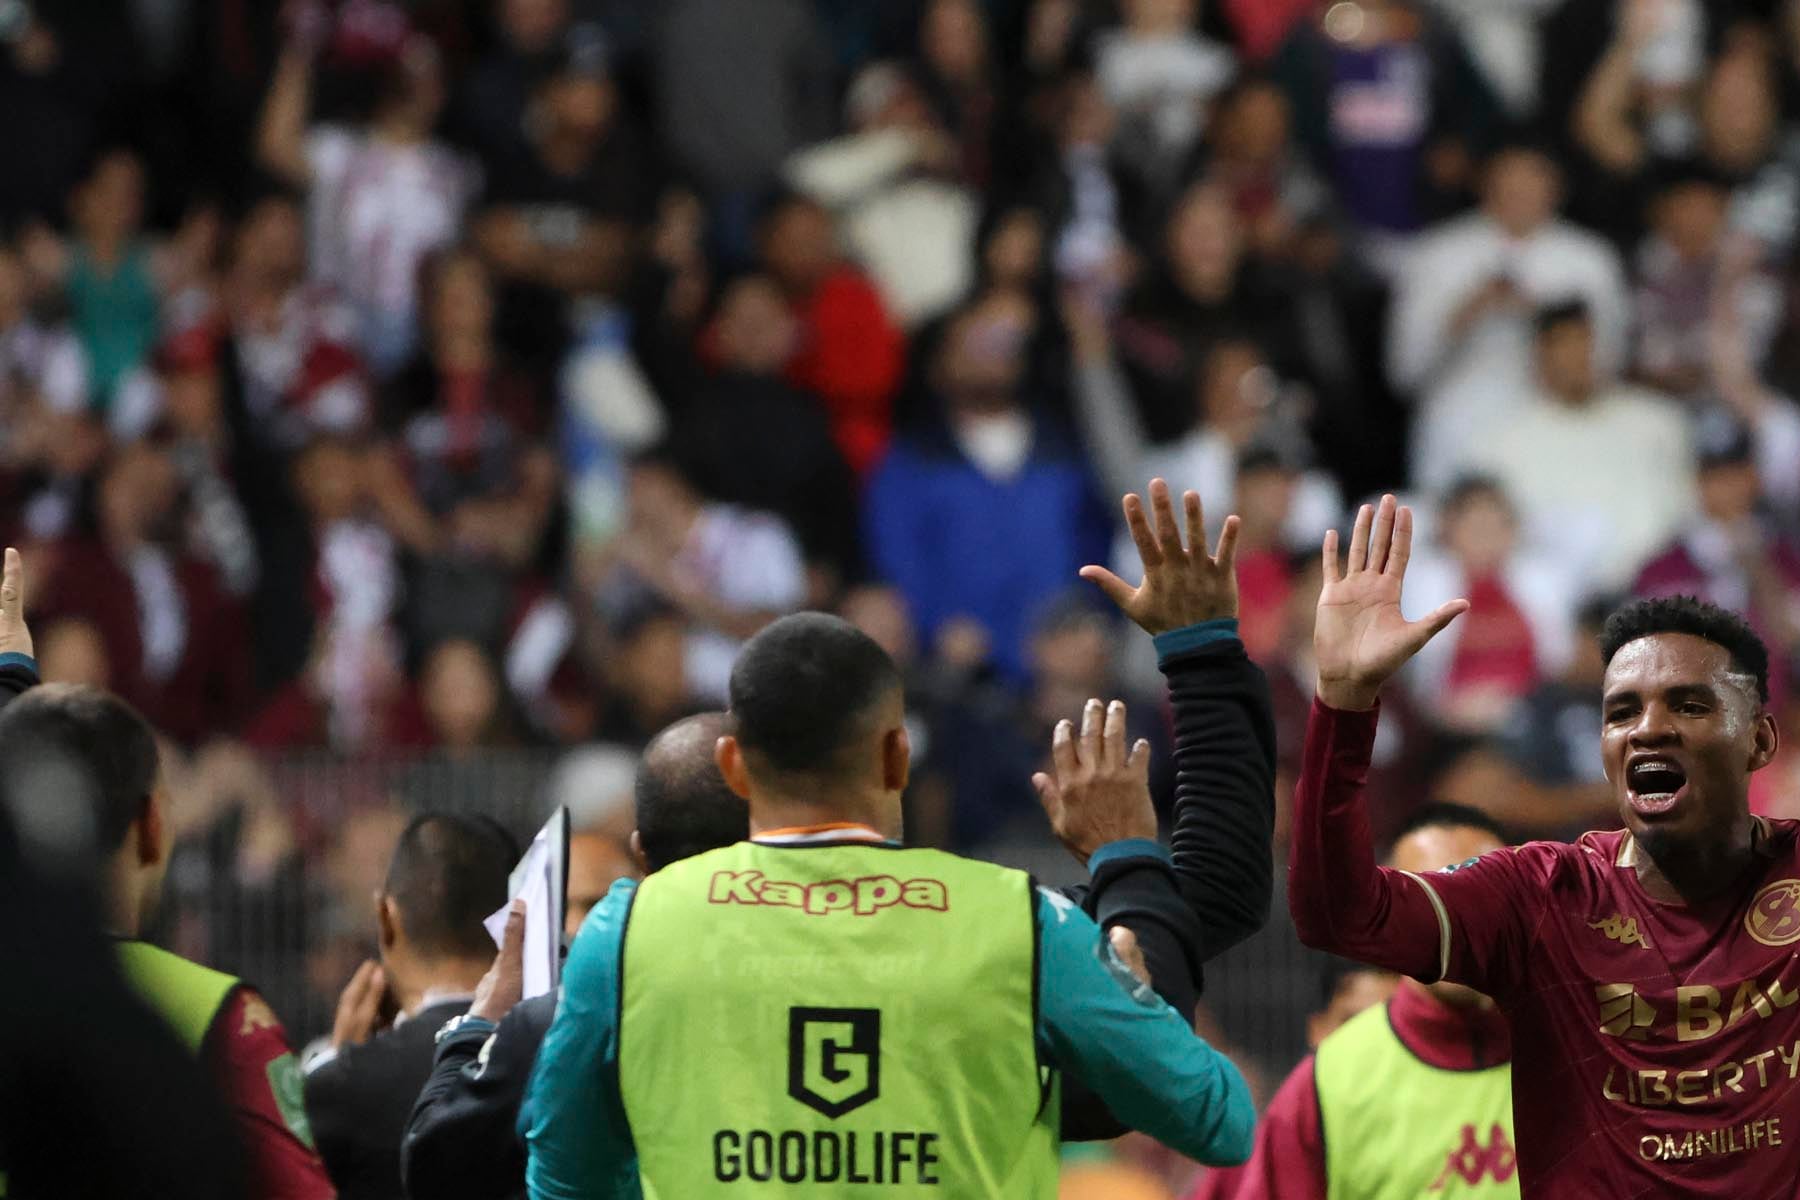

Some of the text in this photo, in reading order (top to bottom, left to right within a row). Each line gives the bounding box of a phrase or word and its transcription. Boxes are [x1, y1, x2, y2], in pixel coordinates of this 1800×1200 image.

[708, 870, 950, 916] Kappa
[713, 1129, 939, 1185] GOODLIFE
[1638, 1118, 1783, 1161] OMNILIFE
